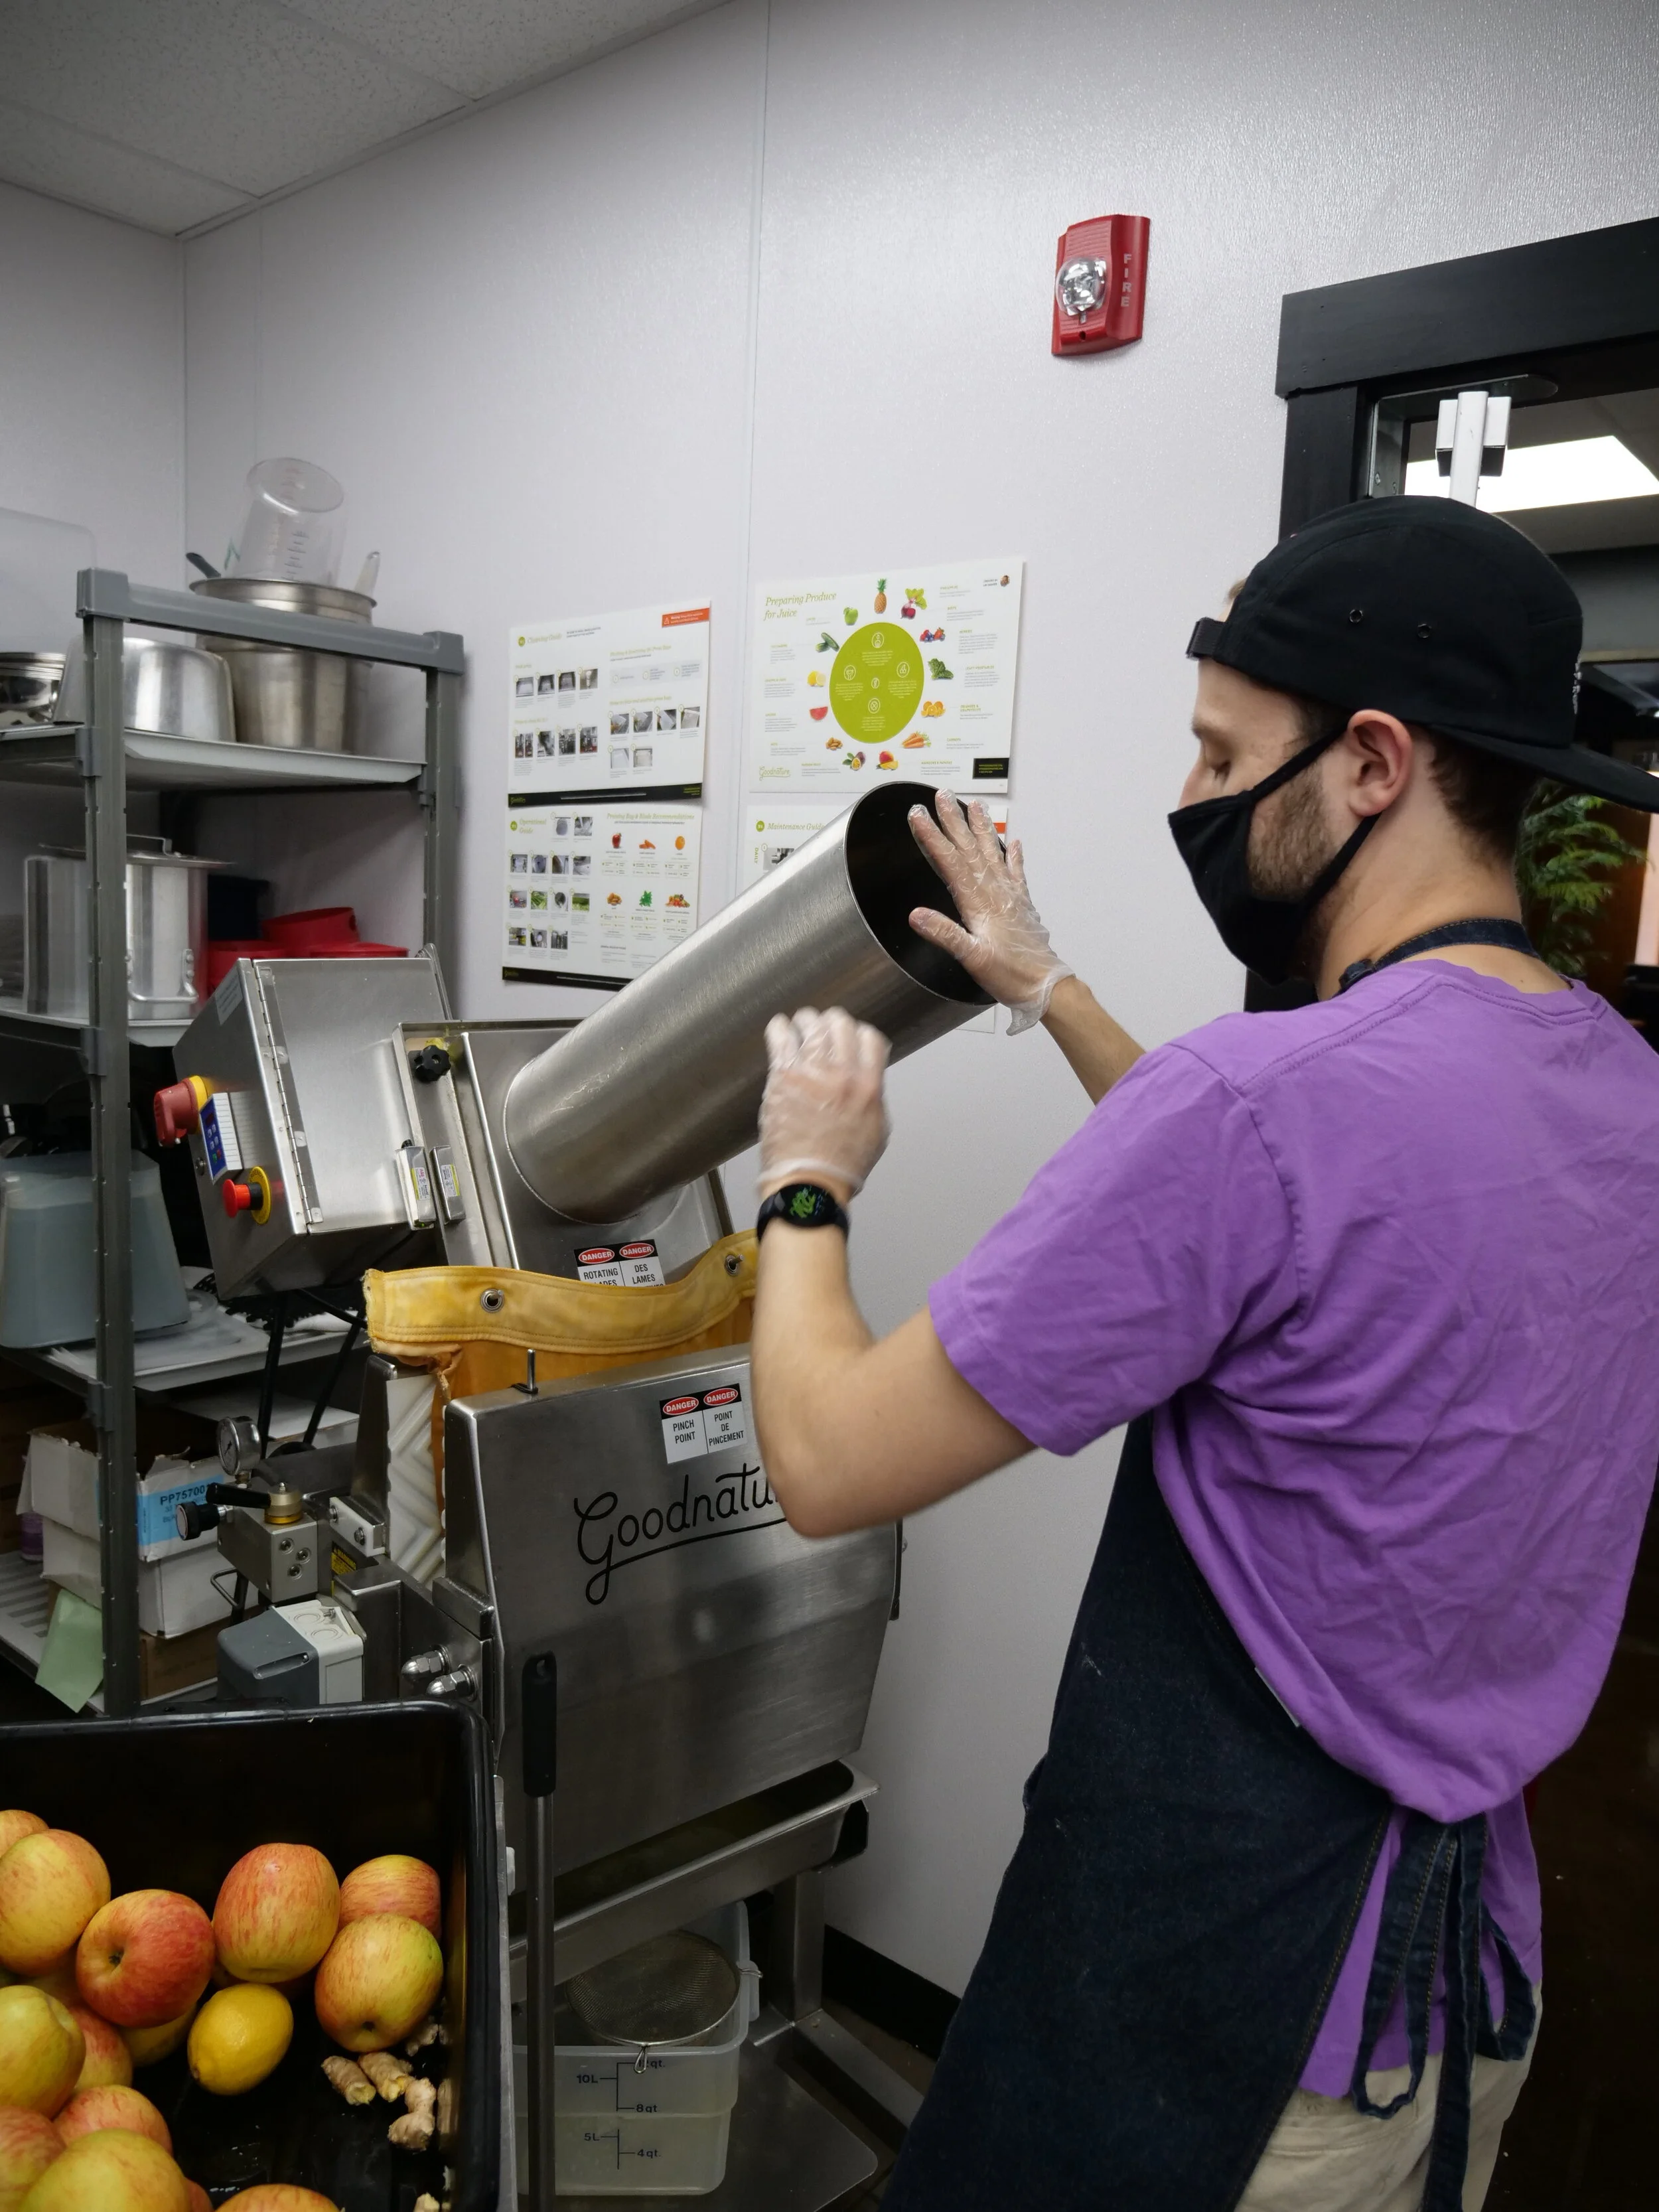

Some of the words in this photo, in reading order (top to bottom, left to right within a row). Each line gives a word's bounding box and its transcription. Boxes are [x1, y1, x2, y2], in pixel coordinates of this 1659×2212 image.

[1121, 253, 1132, 307] FIRE
[766, 595, 804, 607] Preparing
[805, 592, 837, 603] Produce
[763, 610, 776, 621] for
[777, 609, 798, 619] Juice
[759, 766, 790, 780] Goodnature
[582, 1251, 612, 1261] DANGER
[622, 1246, 652, 1256] DANGER
[583, 1268, 618, 1280] ROTATING
[634, 1264, 648, 1272] DES
[632, 1274, 656, 1284] LAMES
[707, 1390, 735, 1403] DANGER
[666, 1400, 696, 1412] DANGER
[714, 1410, 733, 1422] POINT
[673, 1419, 695, 1432] PINCH
[721, 1423, 729, 1432] DE
[675, 1431, 695, 1443] POINT
[709, 1430, 744, 1446] PINCEMENT
[160, 1484, 208, 1505] PP75700
[574, 1463, 786, 1605] Goodnatu
